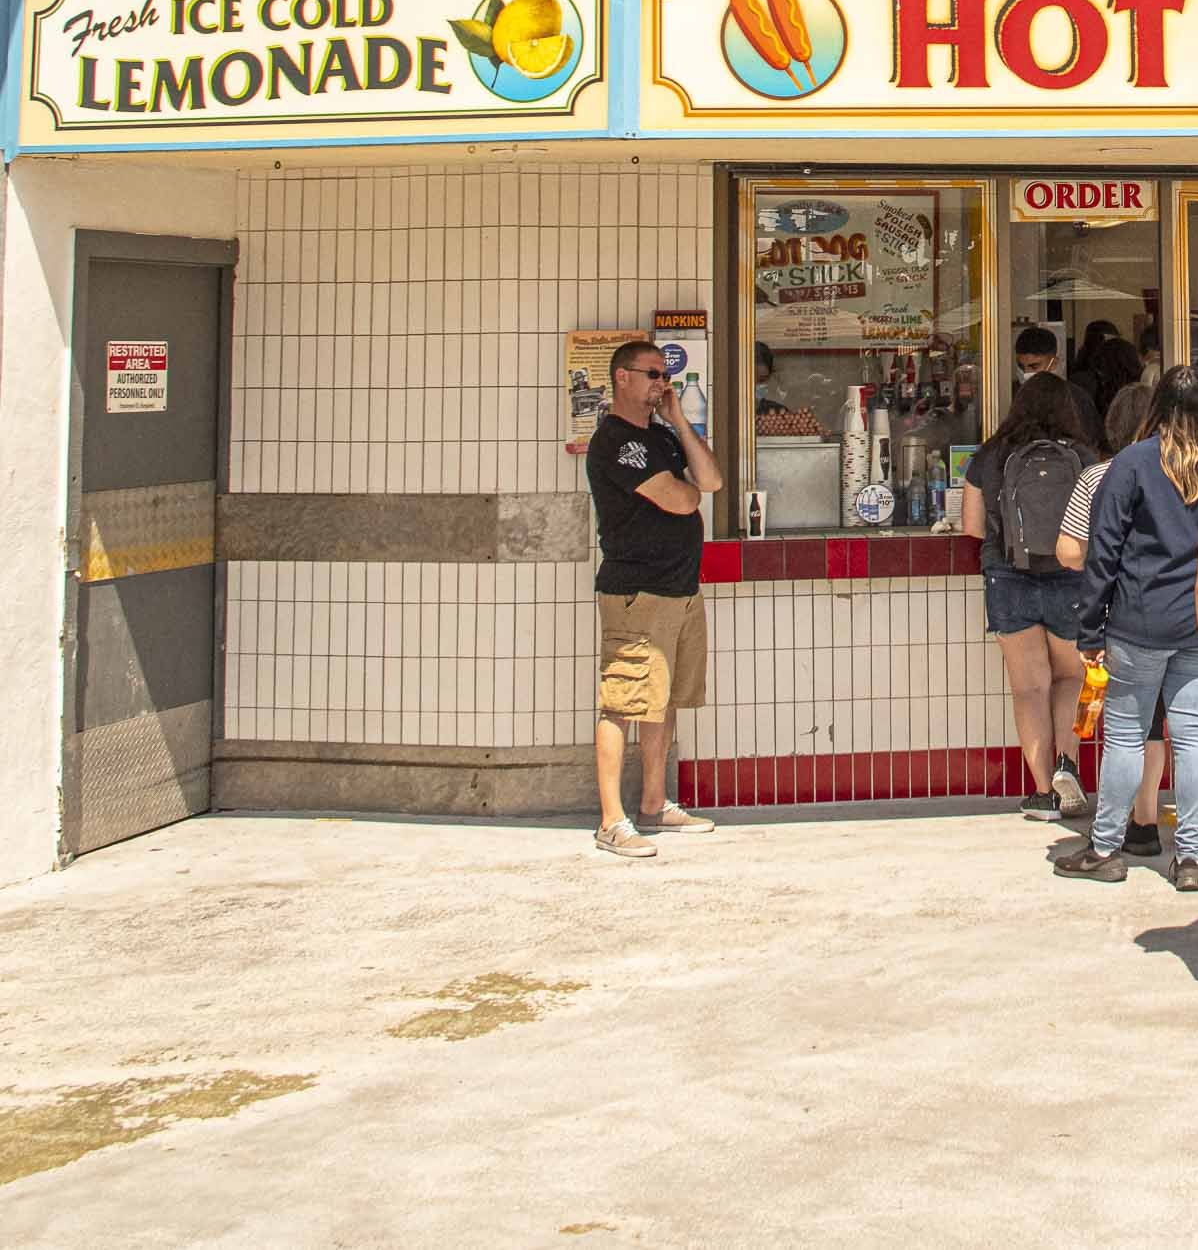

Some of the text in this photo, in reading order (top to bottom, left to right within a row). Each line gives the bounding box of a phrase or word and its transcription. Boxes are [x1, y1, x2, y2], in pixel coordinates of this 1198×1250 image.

[75, 35, 453, 114] LEMONADE
[1023, 180, 1144, 210] ORDER
[883, 212, 922, 239] POLISH
[656, 315, 705, 328] NAPKINS
[110, 345, 166, 357] RESTRICTED
[125, 358, 151, 370] AREA
[116, 373, 158, 384] AUTHORIZED
[109, 387, 166, 399] PERSONNEL ONLY
